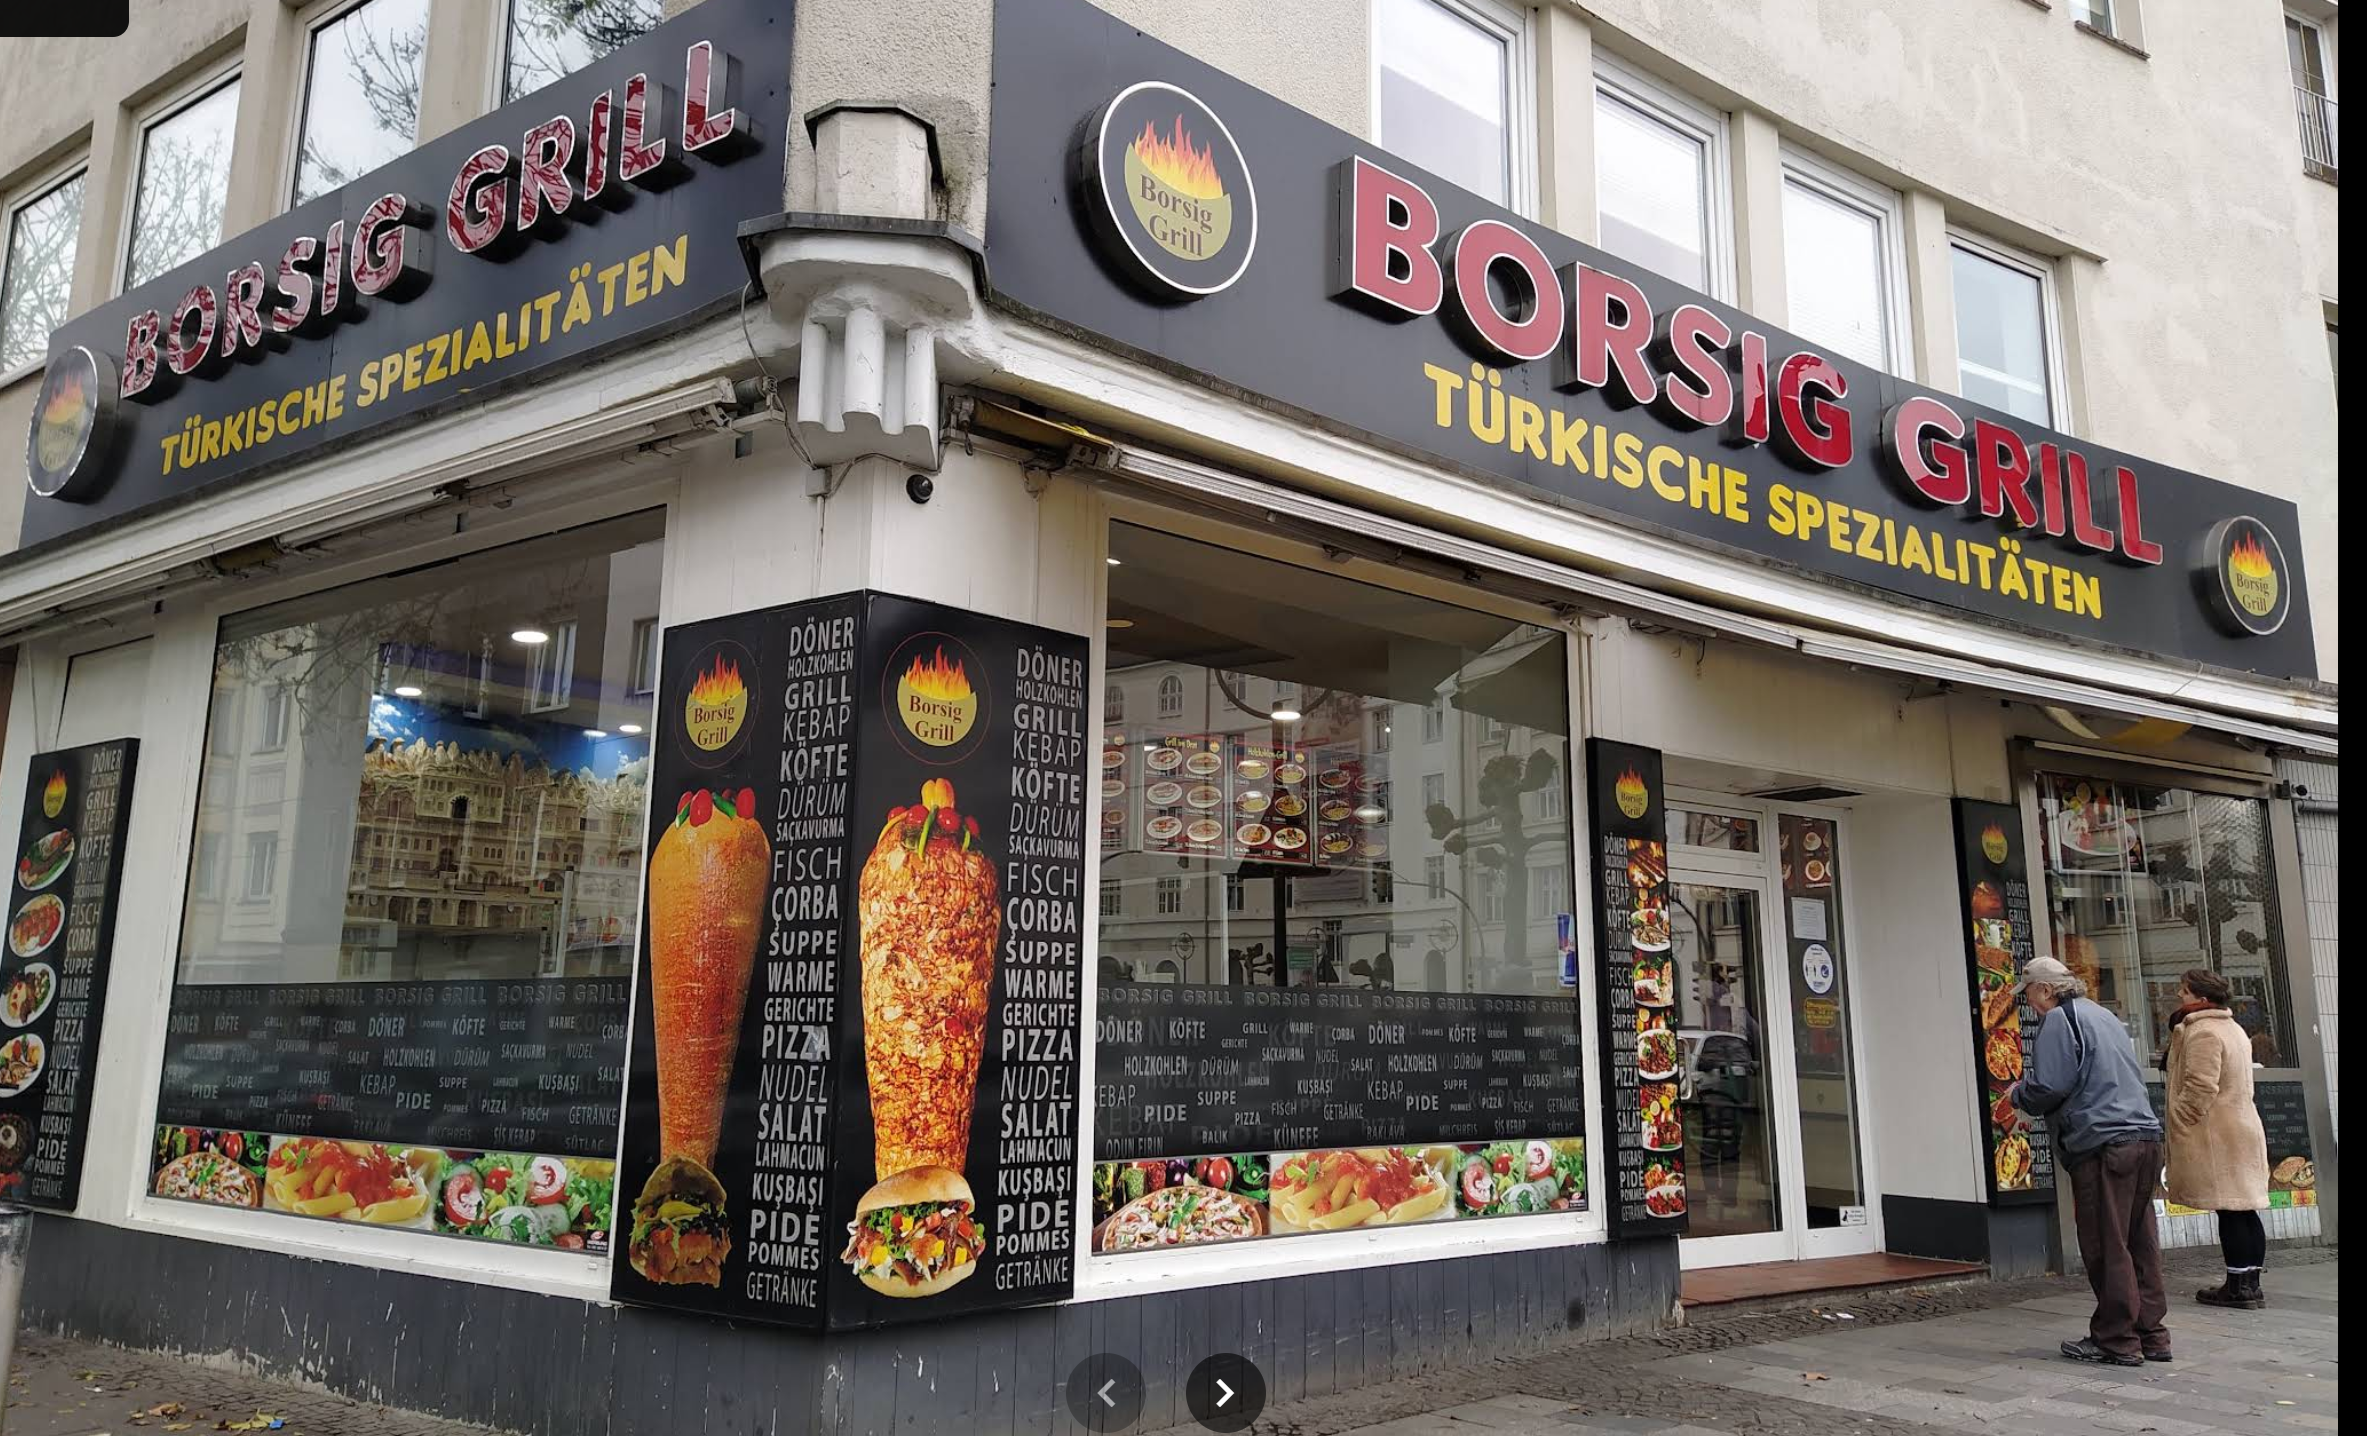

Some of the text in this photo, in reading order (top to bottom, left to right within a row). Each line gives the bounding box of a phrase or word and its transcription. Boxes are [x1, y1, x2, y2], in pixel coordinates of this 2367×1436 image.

[1140, 174, 1213, 234] Borsig
[121, 40, 736, 399] BORSIG GRILL
[1148, 213, 1204, 258] Grill
[161, 234, 689, 476] TÜRKISCHE SPEZIALITÄTEN
[1353, 154, 2164, 566] BORSIG GRILL
[1423, 361, 2102, 619] TÜRKISCHE SPEZIALITÄTEN
[2235, 573, 2270, 597] Borsig
[2242, 593, 2269, 614] Grill
[790, 617, 854, 657] DÖNER
[787, 650, 854, 679] HOLZKOHLEN
[1017, 646, 1083, 688] DÖNER
[785, 675, 851, 710] GRILL
[1015, 679, 1083, 709] HOLZKOHLEN
[694, 704, 735, 725] Borsig
[909, 695, 962, 723] Borsig
[783, 704, 850, 743] KEBAP
[915, 720, 954, 742] Grill
[1014, 704, 1082, 739] GRILL
[697, 726, 728, 747] Grill
[780, 740, 849, 782] KÖFTE
[1013, 730, 1081, 768] KEBAP
[1011, 762, 1080, 805] KÖFTE
[86, 788, 116, 810] GRILL
[777, 777, 847, 820] DÜRÜM
[1010, 799, 1080, 839] DÜRÜM
[776, 817, 845, 846] SAÇKAVURMA
[1009, 836, 1080, 861] SAÇKAVURMA
[773, 847, 841, 882] FISCH
[1007, 862, 1077, 897] FISCH
[1605, 869, 1629, 887] GRILL
[69, 903, 101, 925] FISCH
[771, 884, 839, 931] ÇORBA
[1006, 897, 1077, 939] ÇORBA
[769, 929, 837, 957] SUPPE
[1005, 938, 1076, 966] SUPPE
[62, 957, 93, 975] SUPPE
[768, 961, 835, 992] WARME
[1610, 966, 1634, 987] FISCH
[59, 978, 90, 999] WARME
[499, 984, 566, 1005] BORSIG
[574, 984, 627, 1005] GRILL
[1005, 968, 1075, 1000] WARME
[764, 997, 834, 1022] GERICHTE
[1099, 987, 1173, 1005] BORSIG
[1181, 988, 1233, 1006] GRILL
[1244, 991, 1310, 1007] BORSIG
[1317, 993, 1362, 1008] GRILL
[1372, 995, 1431, 1010] BORSIG
[1437, 997, 1477, 1012] GRILL
[367, 1012, 405, 1037] DÖNER
[452, 1014, 486, 1035] KÖFTE
[548, 1016, 575, 1030] WARME
[1003, 1002, 1075, 1027] GERICHTE
[1612, 1013, 1635, 1028] SUPPE
[53, 1019, 84, 1042] PIZZA
[1096, 1016, 1143, 1043] DÖNER
[1169, 1017, 1206, 1039] KÖFTE
[1243, 1022, 1268, 1034] GRILL
[1368, 1020, 1405, 1045] DÖNER
[1448, 1023, 1476, 1043] KÖFTE
[762, 1025, 831, 1061] PIZZA
[1002, 1028, 1074, 1062] PIZZA
[48, 1045, 81, 1070] NUDEL
[383, 1048, 435, 1068] HOLZKOHLEN
[1124, 1055, 1188, 1076] HOLZKOHLEN
[1201, 1056, 1239, 1077] DÜRÜM
[1315, 1049, 1339, 1063] NUDEL
[1351, 1058, 1373, 1072] SALAT
[1388, 1054, 1437, 1072] HOLZKOHLEN
[46, 1070, 79, 1095] SALAT
[225, 1075, 253, 1089] SUPPE
[438, 1076, 468, 1089] SUPPE
[759, 1064, 828, 1103] NUDEL
[1000, 1065, 1072, 1101] NUDEL
[1562, 1066, 1580, 1078] SALAT
[1615, 1067, 1639, 1087] PIZZA
[191, 1084, 219, 1100] PIDE
[360, 1074, 397, 1095] KEBAP
[538, 1074, 580, 1095] KUŞBAŞI
[1297, 1079, 1333, 1098] KUŞBAŞI
[1367, 1080, 1404, 1101] KEBAP
[1443, 1079, 1468, 1090] SUPPE
[249, 1095, 269, 1108] PIZZA
[395, 1092, 431, 1110] PIDE
[481, 1099, 507, 1114] PIZZA
[1197, 1091, 1237, 1106] SUPPE
[1271, 1102, 1297, 1116] FISCH
[1406, 1095, 1439, 1111] PIDE
[1482, 1097, 1503, 1109] PIZZA
[1513, 1101, 1534, 1113] FISCH
[522, 1106, 549, 1122] FISCH
[569, 1103, 617, 1127] GETRÄNKE
[757, 1103, 827, 1143] SALAT
[1001, 1102, 1072, 1139] SALAT
[1144, 1104, 1187, 1122] PIDE
[1235, 1112, 1261, 1126] PIZZA
[1323, 1102, 1364, 1120] GETRÄNKE
[1617, 1111, 1641, 1133] SALAT
[36, 1138, 68, 1160] PIDE
[1106, 1138, 1135, 1159] ODUN
[1202, 1130, 1229, 1145] BALIK
[755, 1141, 825, 1171] LAHMACUN
[1000, 1138, 1071, 1165] LAHMACUN
[2031, 1150, 2051, 1164] PIDE
[998, 1166, 1071, 1200] KUŞBAŞI
[1620, 1169, 1645, 1189] PIDE
[753, 1173, 823, 1213] KUŞBAŞI
[750, 1209, 820, 1246] PIDE
[997, 1199, 1070, 1233] PIDE
[996, 1228, 1070, 1256] POMMES
[748, 1241, 820, 1270] POMMES
[995, 1254, 1069, 1290] GETRÄNKE
[747, 1270, 817, 1308] GETRÄNKE
